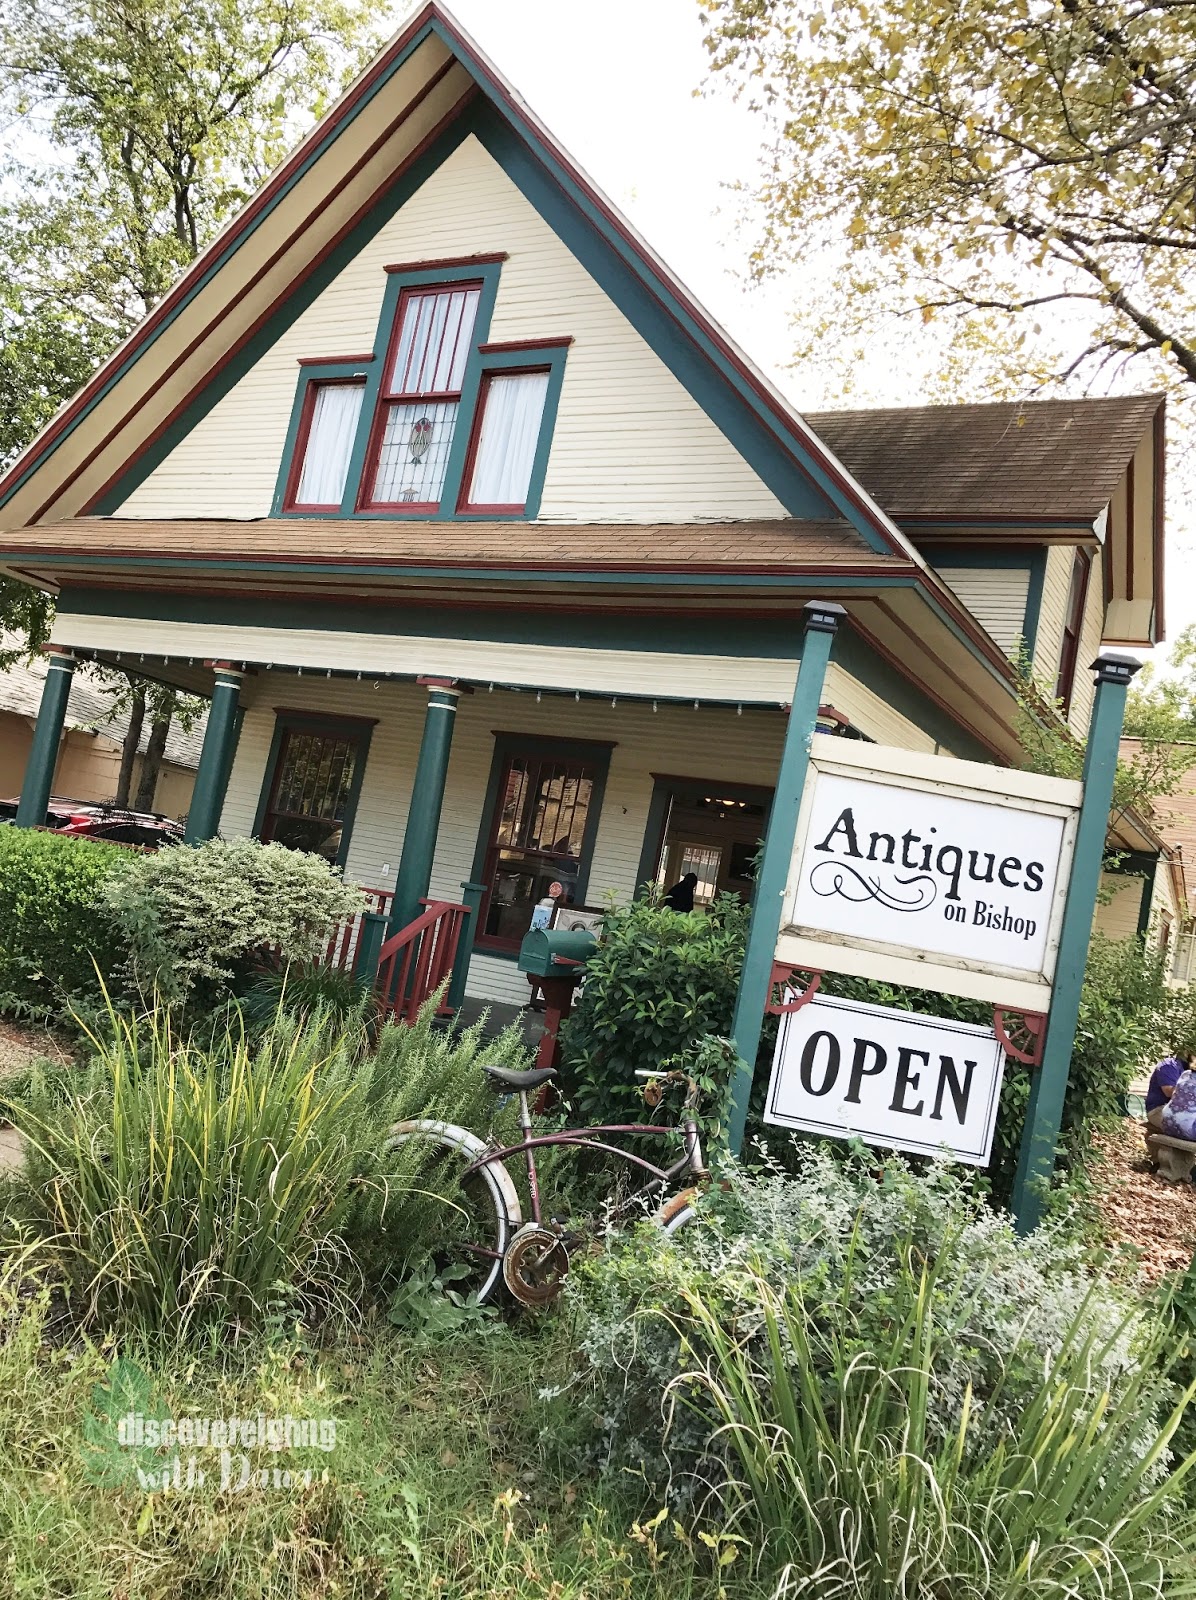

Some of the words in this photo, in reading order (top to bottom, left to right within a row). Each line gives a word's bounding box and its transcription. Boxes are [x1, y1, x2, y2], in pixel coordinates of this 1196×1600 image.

[814, 808, 1044, 901] Antiques
[944, 904, 967, 923] on
[971, 901, 1037, 940] Bishop
[800, 1030, 978, 1126] OPEN
